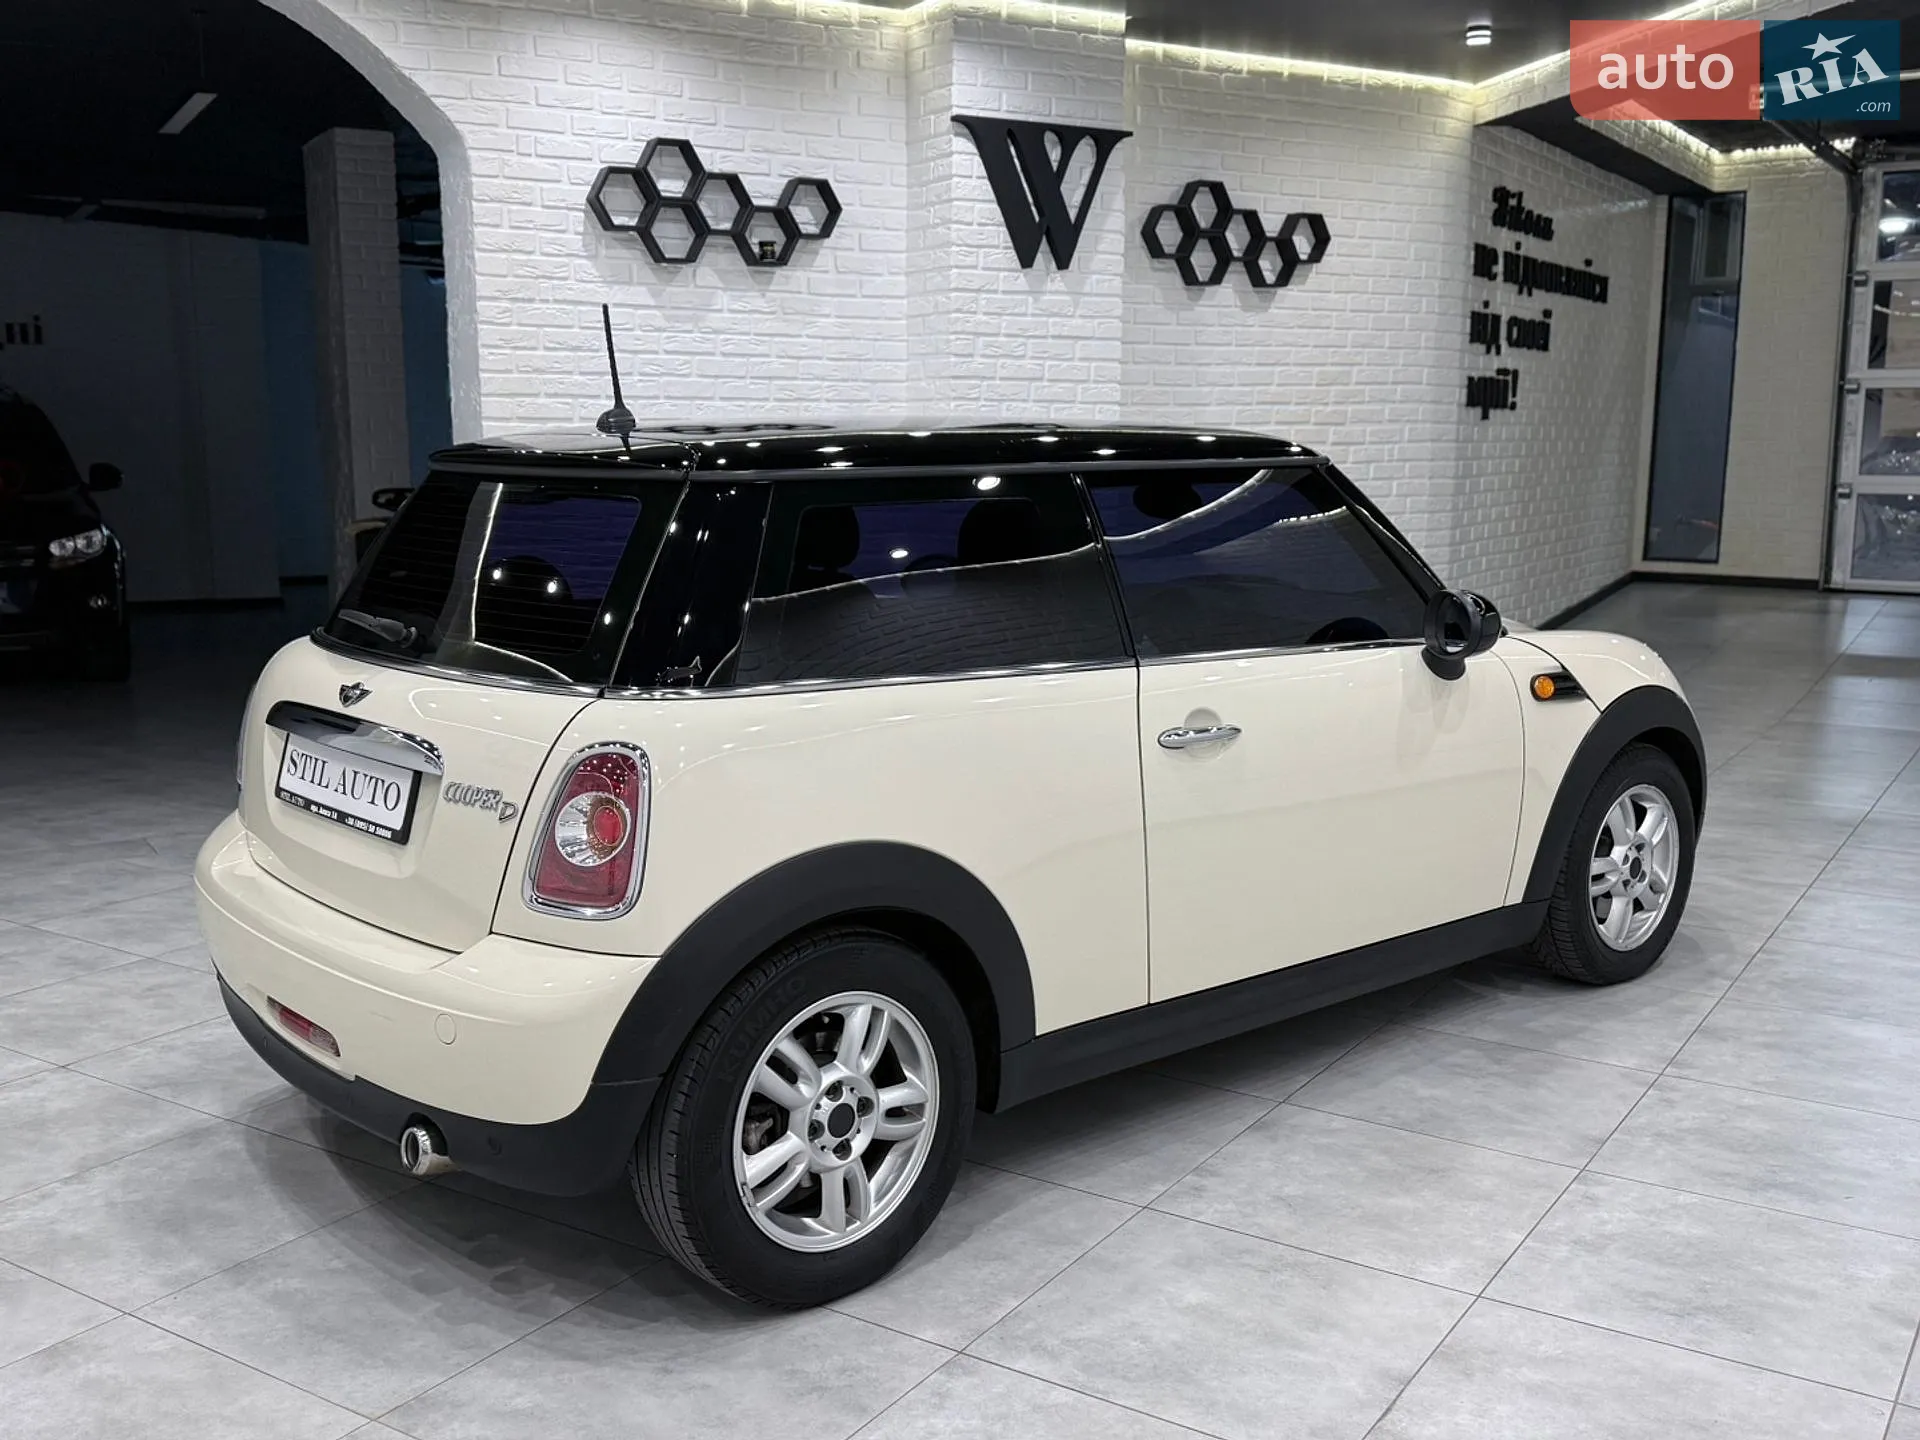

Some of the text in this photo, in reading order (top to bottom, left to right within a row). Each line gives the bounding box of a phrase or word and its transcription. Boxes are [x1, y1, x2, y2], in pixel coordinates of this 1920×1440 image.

[950, 114, 1134, 271] W
[286, 748, 402, 813] STIL AUTO
[443, 781, 519, 824] COOPER D
